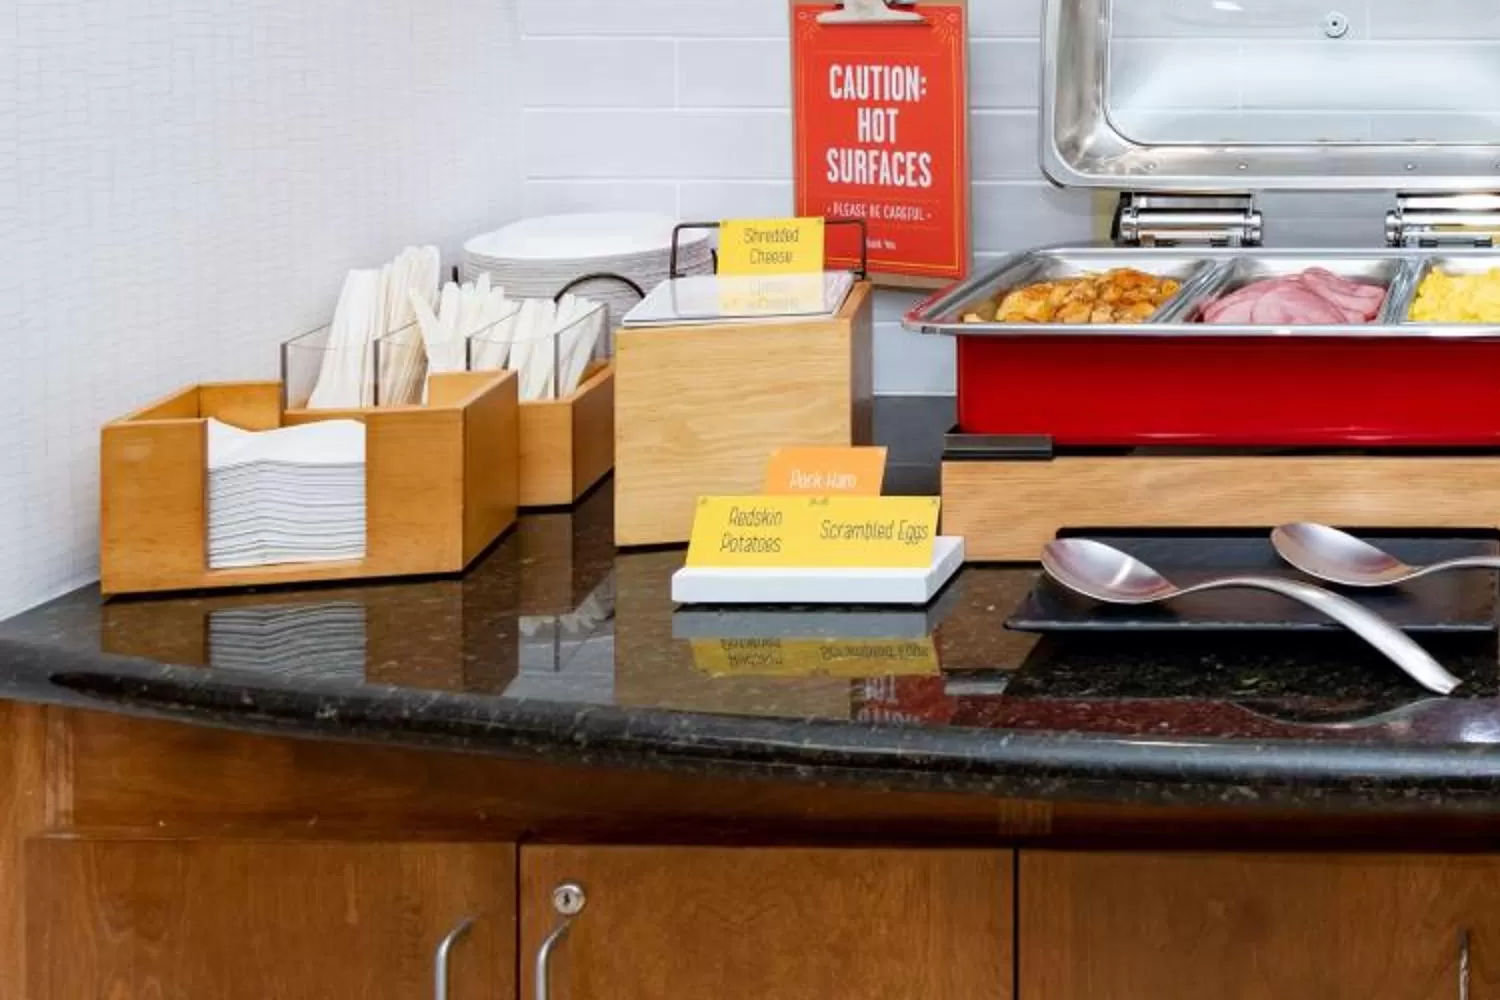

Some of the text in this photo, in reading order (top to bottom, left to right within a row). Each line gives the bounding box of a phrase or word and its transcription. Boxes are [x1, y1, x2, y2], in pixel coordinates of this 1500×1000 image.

[829, 63, 928, 104] CAUTION:
[857, 107, 899, 145] HOT
[826, 146, 932, 189] SURFACES
[832, 200, 925, 221] PLEASE BE CAREFUL
[743, 227, 800, 244] Shredded
[749, 247, 793, 265] Cheese
[728, 506, 783, 527] Redskin
[719, 533, 783, 553] Potatoes
[819, 519, 929, 546] Scrambled Eggs
